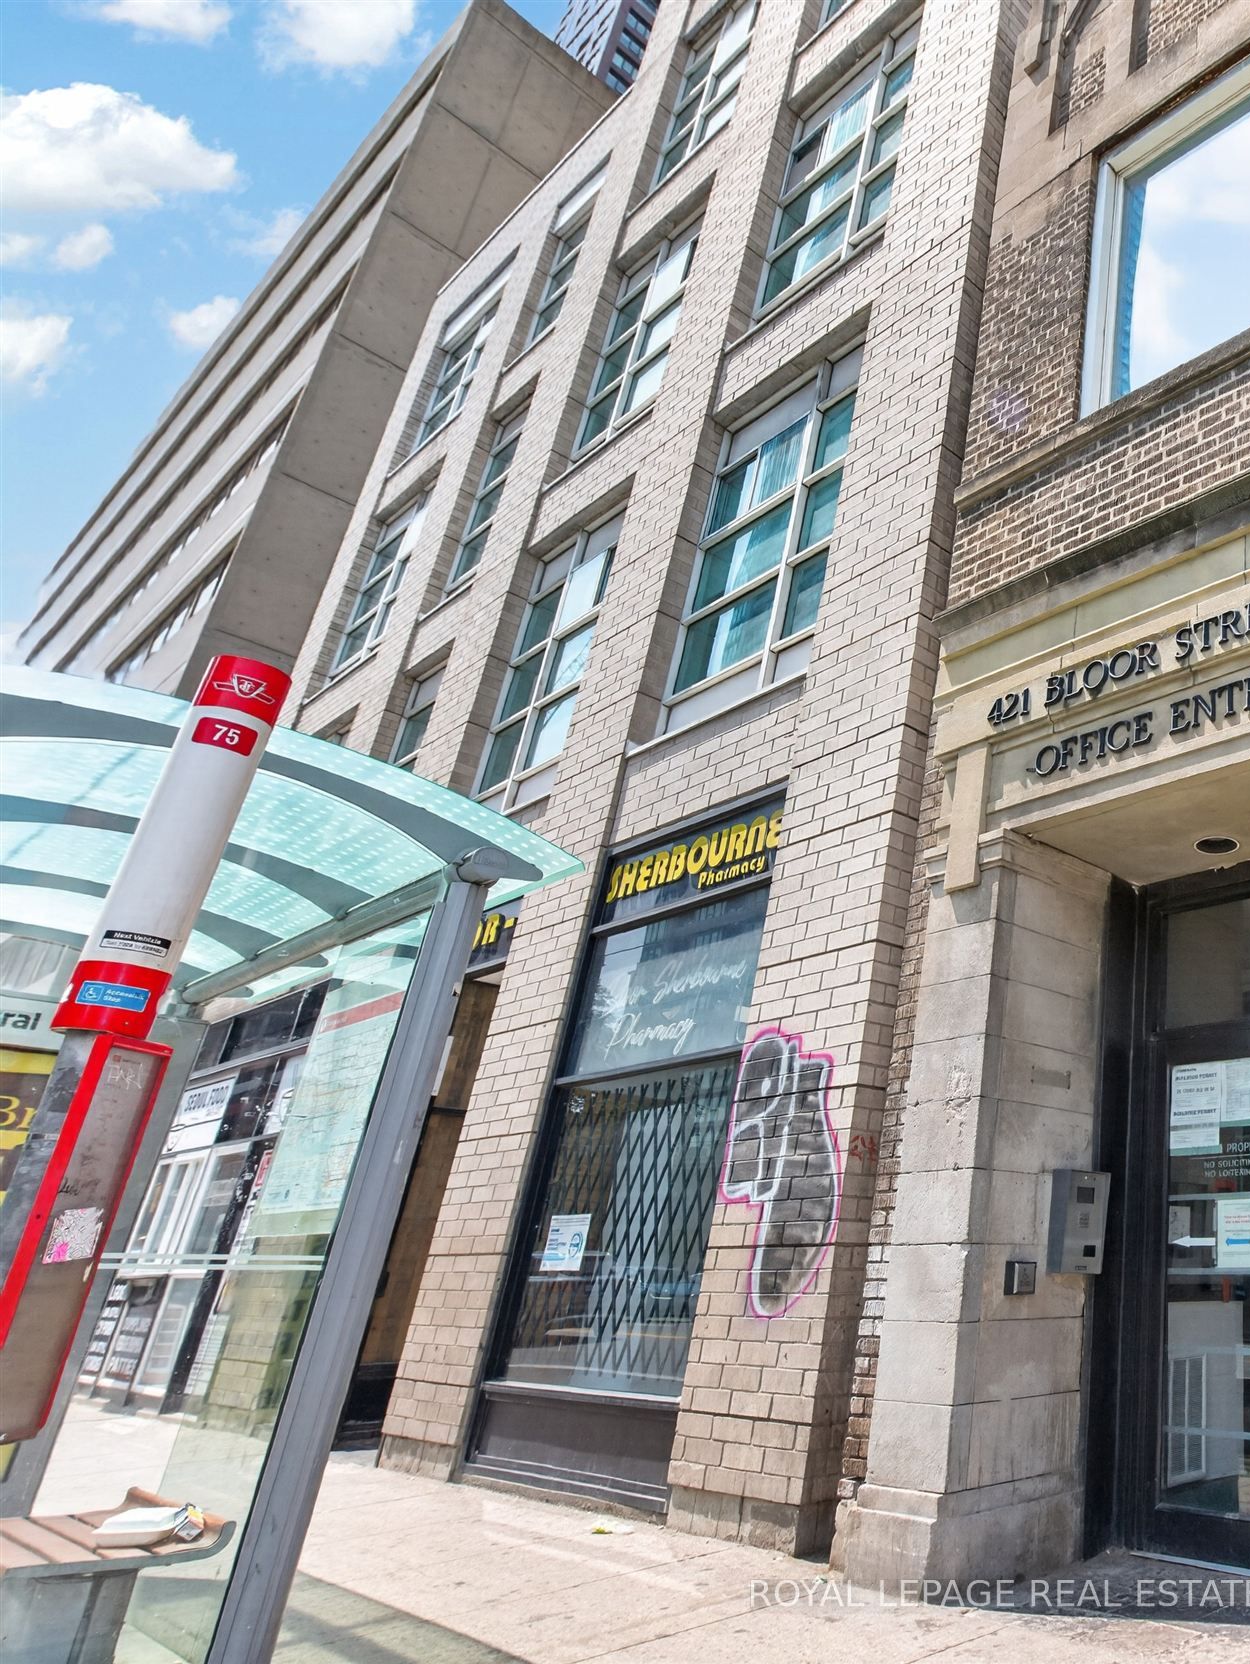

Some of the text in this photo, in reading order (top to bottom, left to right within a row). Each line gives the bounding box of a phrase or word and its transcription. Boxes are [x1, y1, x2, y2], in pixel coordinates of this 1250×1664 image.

[987, 687, 1030, 726] 421
[1044, 641, 1158, 708] BLOOR
[213, 724, 240, 745] 75
[1034, 711, 1153, 777] OFFICE
[606, 809, 785, 903] SHERBOURNE
[697, 855, 766, 889] Pharmacy
[604, 1012, 697, 1062] Pharmacy
[1203, 1160, 1216, 1169] NO
[1204, 1169, 1217, 1178] NO
